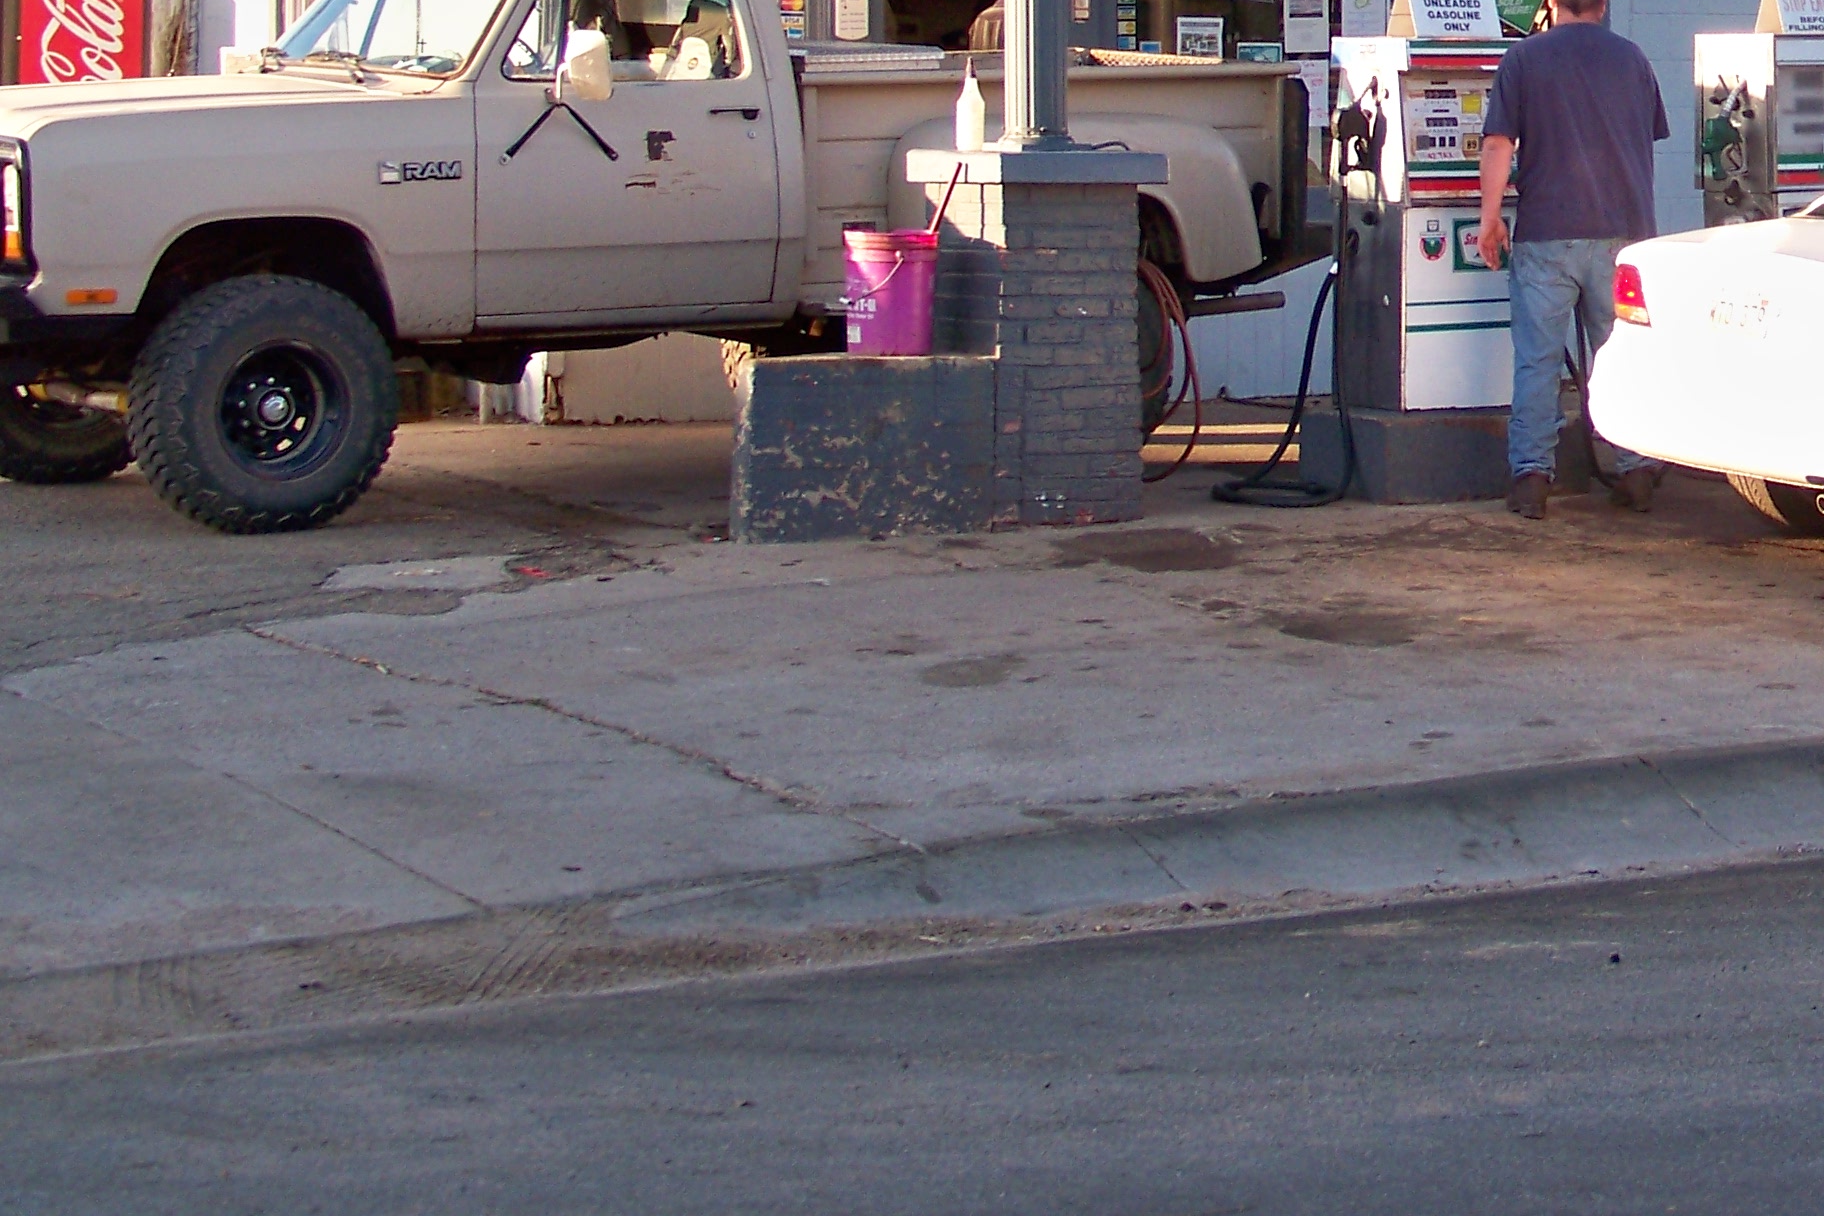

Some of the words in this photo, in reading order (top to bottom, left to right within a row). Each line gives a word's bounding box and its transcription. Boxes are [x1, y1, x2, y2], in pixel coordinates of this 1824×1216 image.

[1427, 10, 1481, 20] GASOLINE
[1444, 22, 1470, 31] ONLY
[403, 160, 462, 181] RAM
